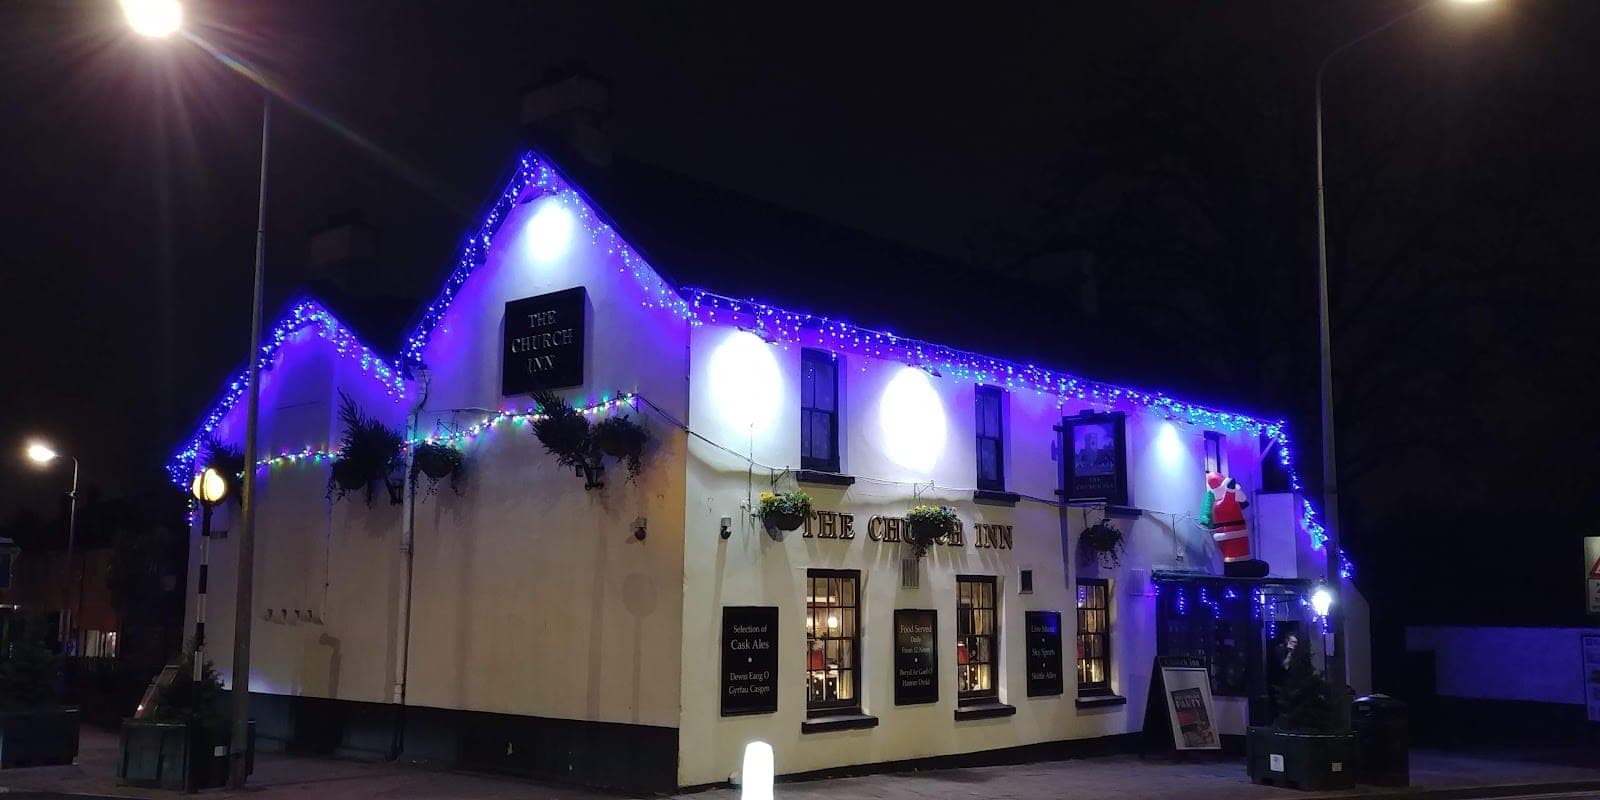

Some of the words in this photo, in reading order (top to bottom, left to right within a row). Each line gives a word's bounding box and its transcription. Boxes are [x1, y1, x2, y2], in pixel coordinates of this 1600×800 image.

[528, 310, 557, 328] THE
[511, 328, 573, 353] CHURCH
[528, 355, 555, 374] INN
[803, 510, 856, 540] THE
[974, 523, 1013, 550] INN
[732, 624, 760, 634] Selection
[760, 624, 768, 633] of
[900, 625, 914, 633] Food
[915, 625, 932, 633] Served
[730, 639, 751, 650] Cask
[751, 638, 770, 650] Ales
[763, 671, 770, 680] O
